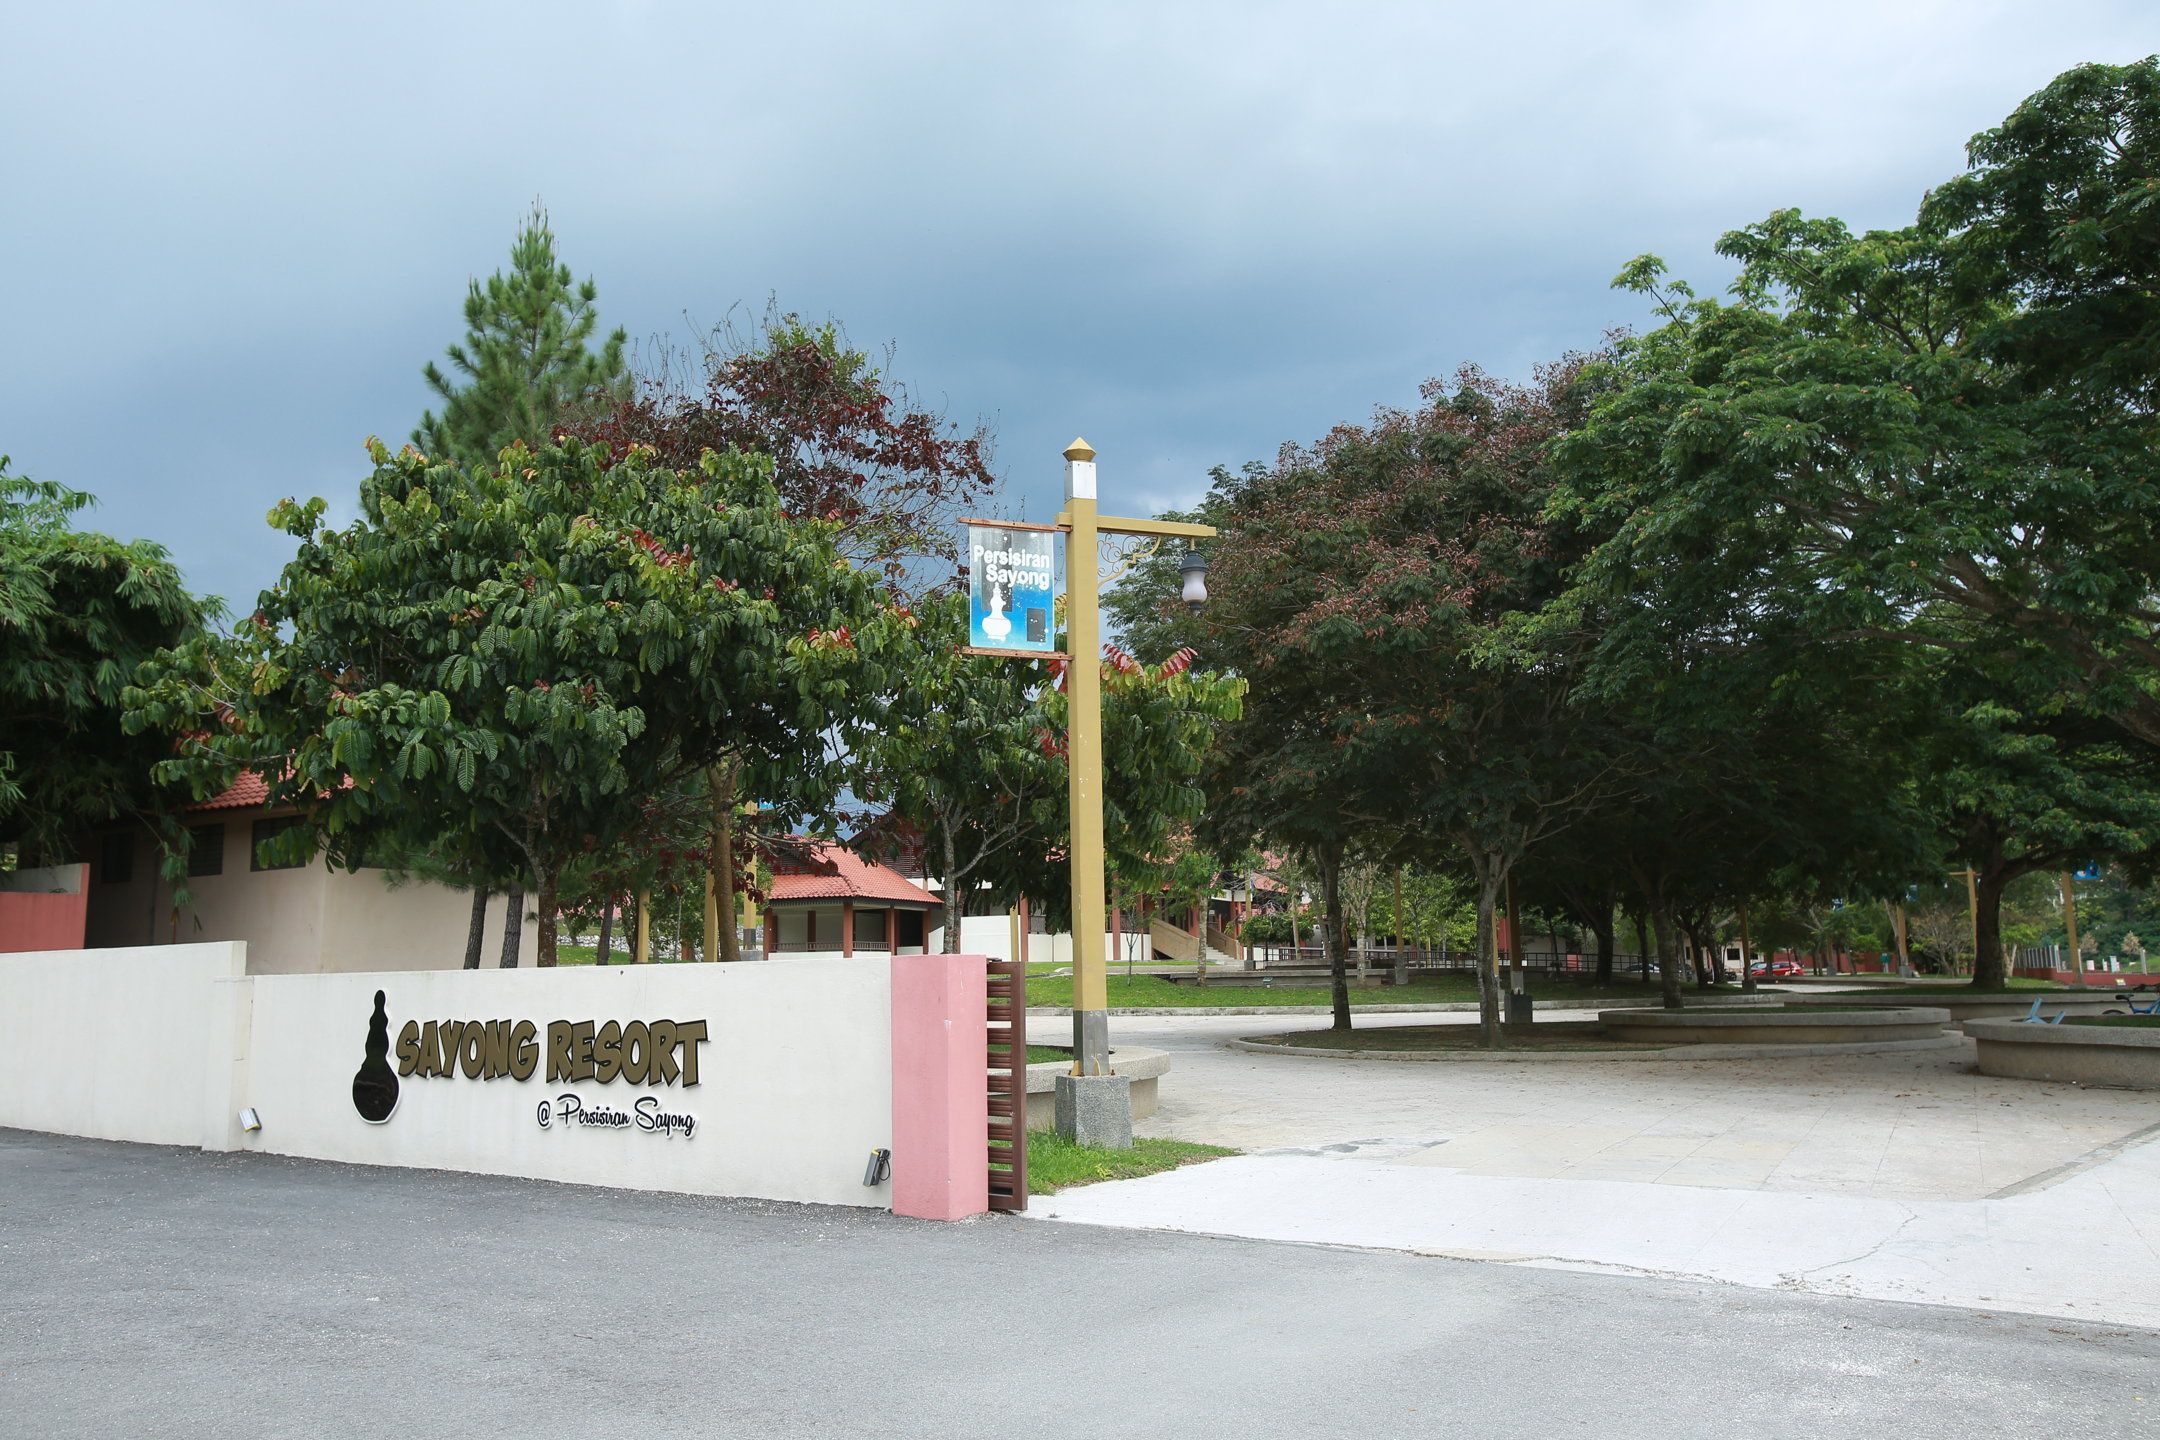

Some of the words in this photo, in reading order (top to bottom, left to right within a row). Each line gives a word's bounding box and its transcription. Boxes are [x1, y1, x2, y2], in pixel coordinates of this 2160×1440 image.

[973, 544, 1050, 569] Persisiran
[985, 563, 1050, 590] Sayong
[396, 1019, 539, 1082] SAYONG
[546, 1019, 708, 1088] RESORT
[537, 1100, 551, 1127] @
[556, 1093, 630, 1126] Persisiran
[634, 1096, 696, 1137] Sayong
